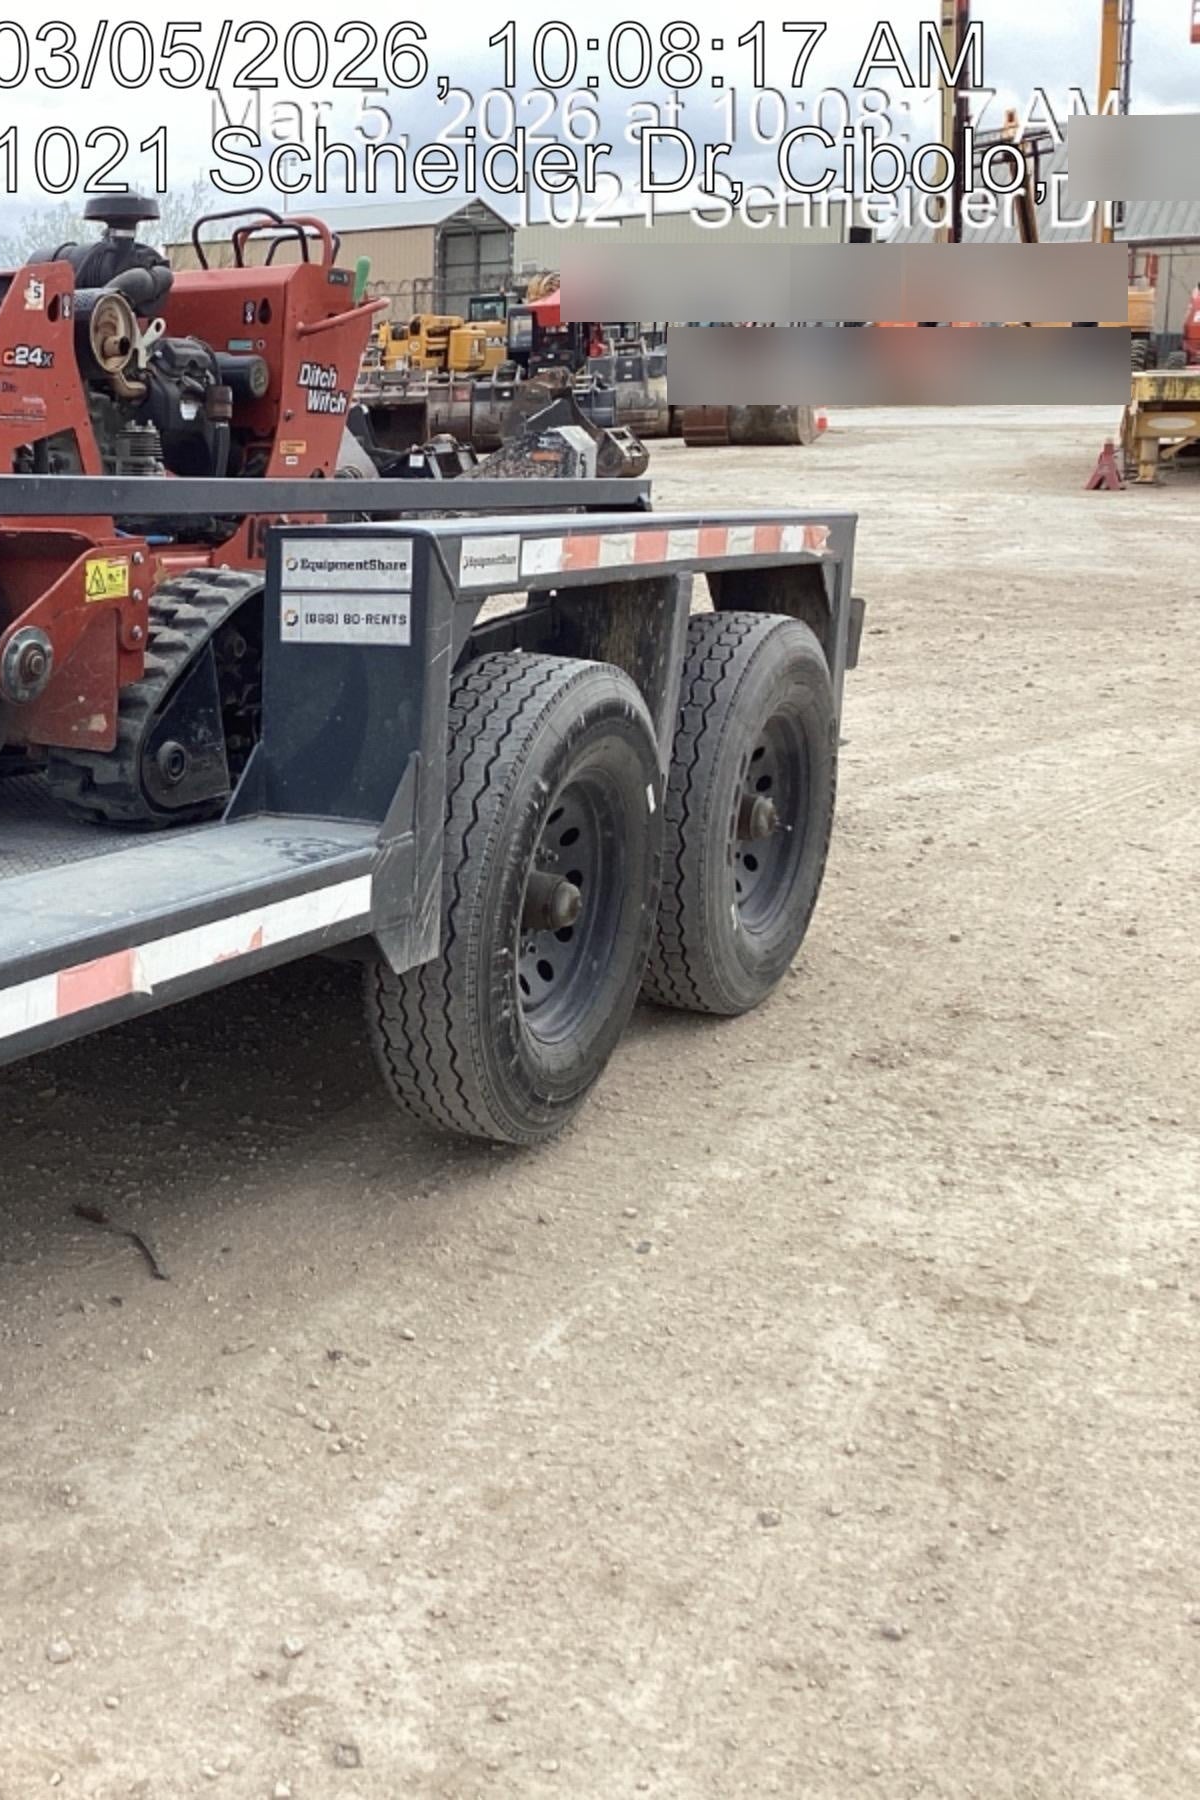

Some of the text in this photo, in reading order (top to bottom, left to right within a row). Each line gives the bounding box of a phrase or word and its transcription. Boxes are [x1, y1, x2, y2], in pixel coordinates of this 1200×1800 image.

[299, 363, 338, 388] Ditch
[307, 389, 348, 414] Witch
[300, 558, 407, 573] EquipmentShare
